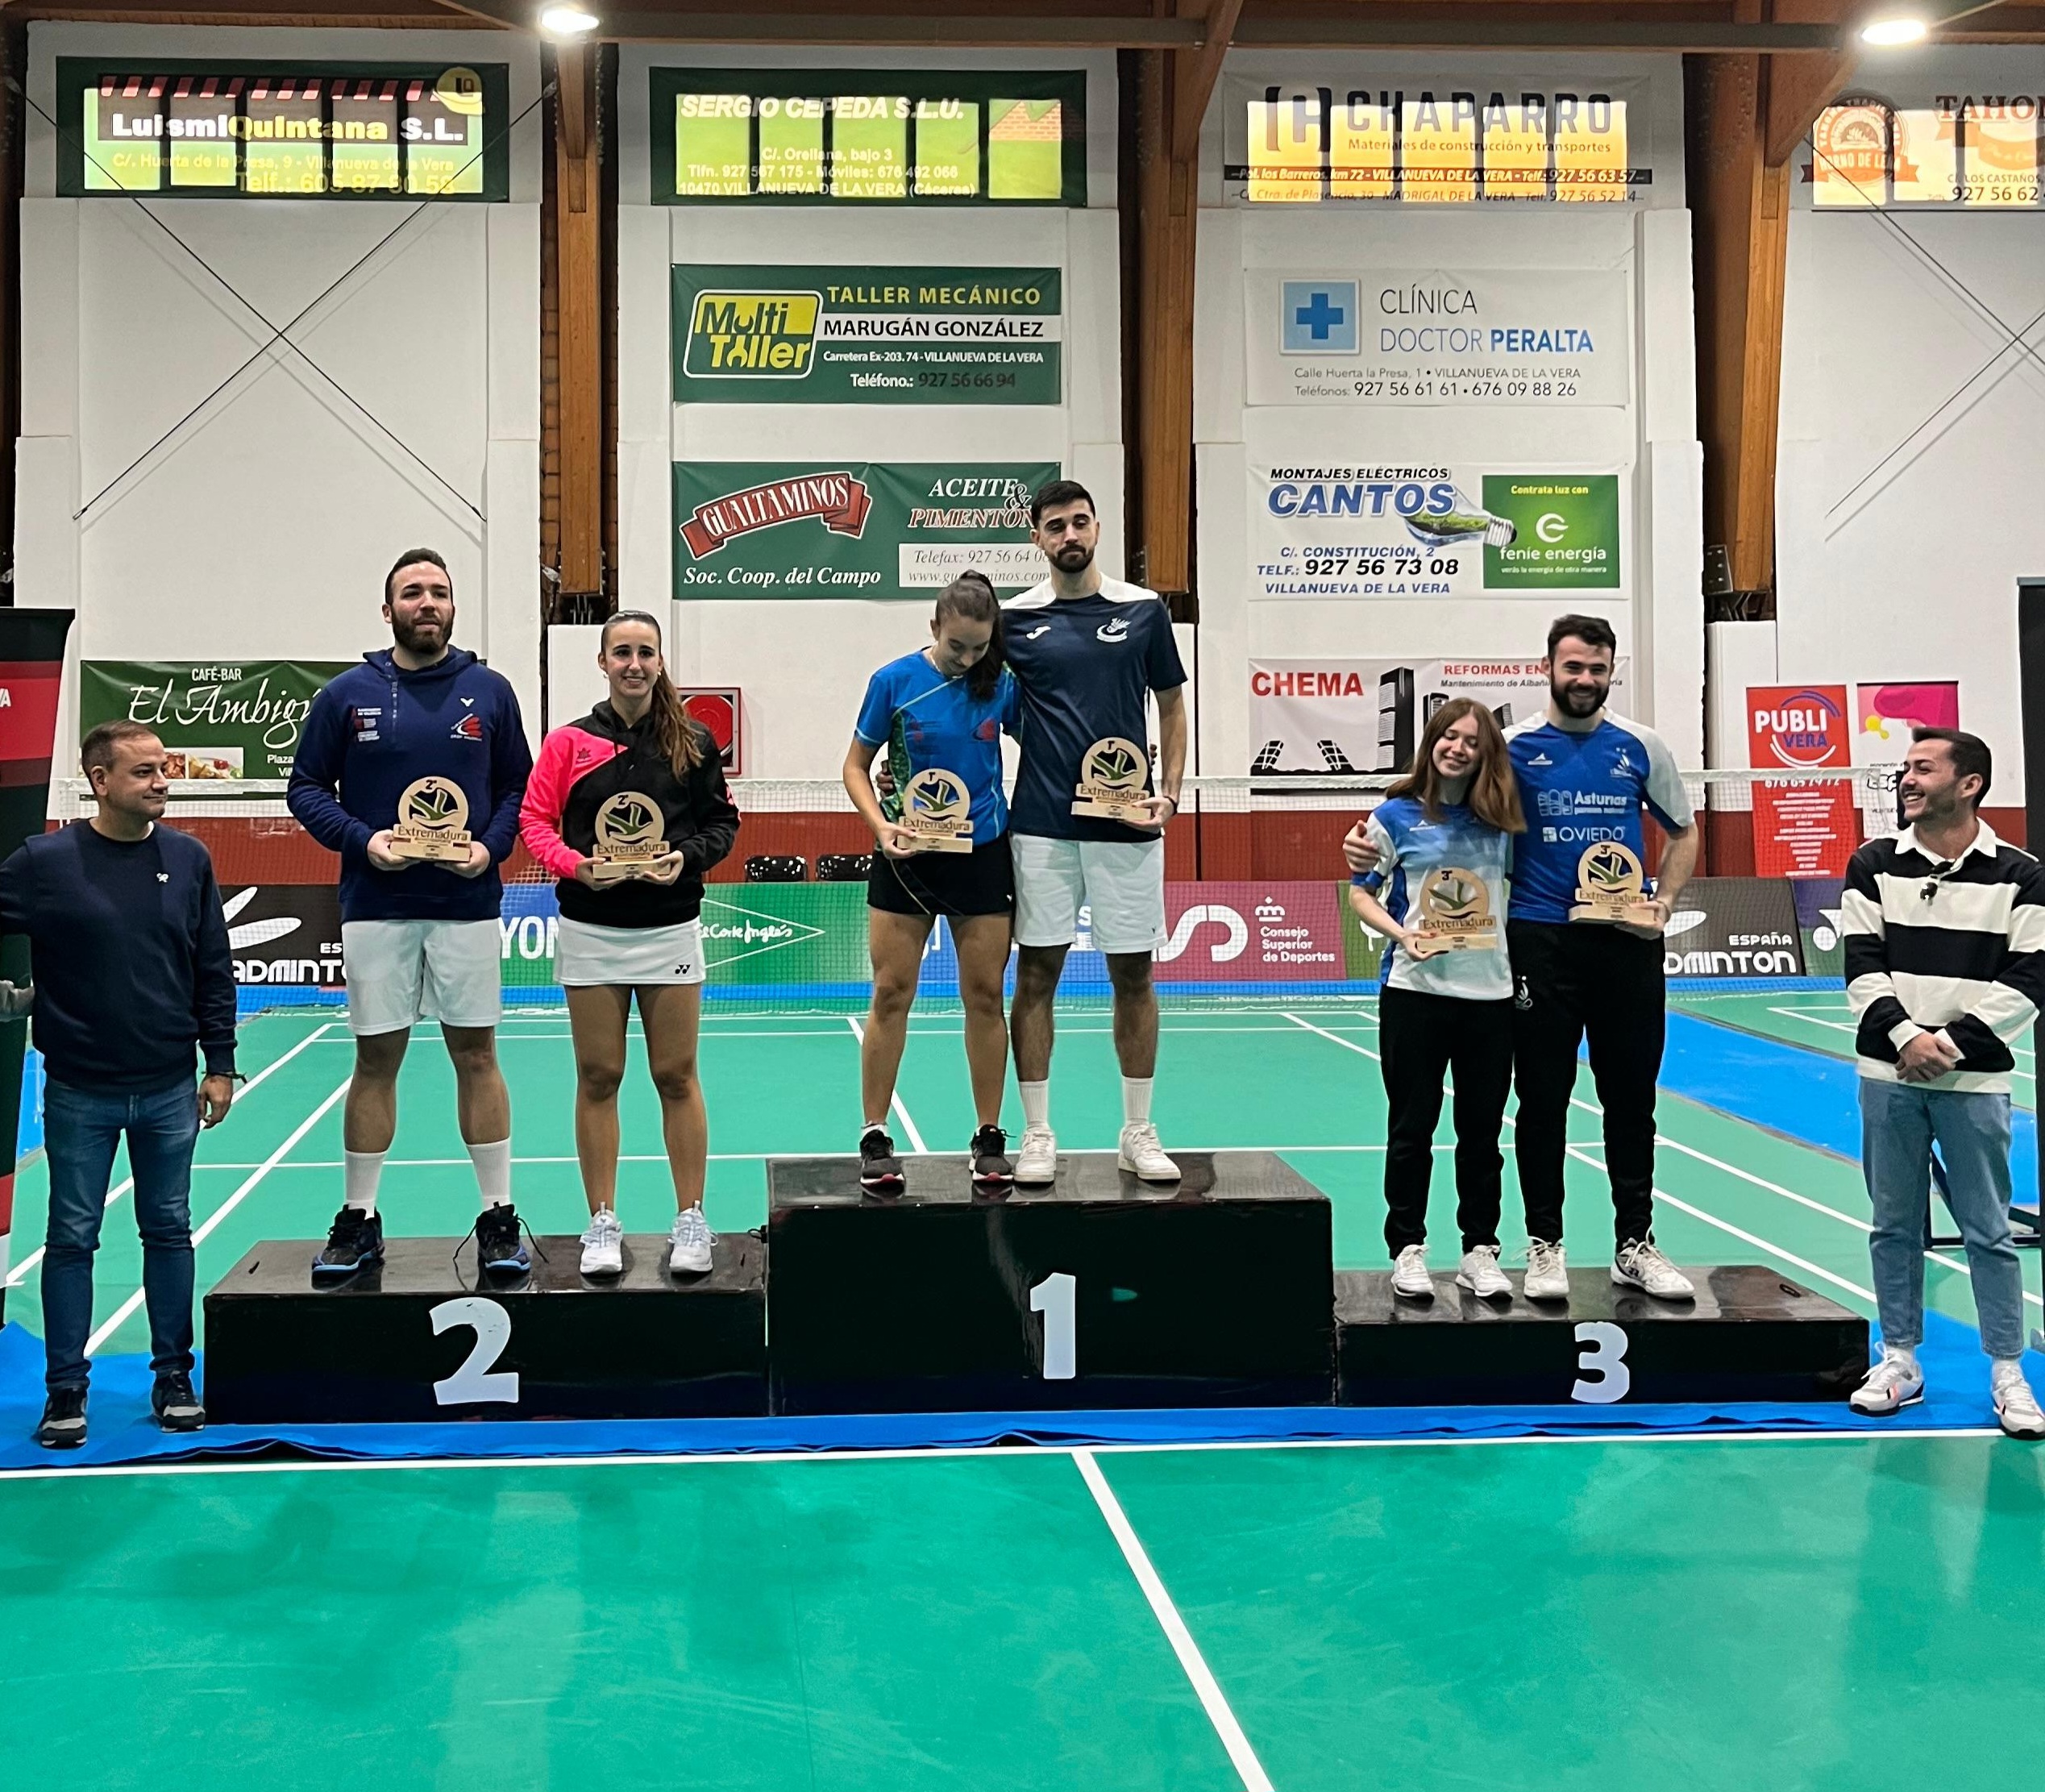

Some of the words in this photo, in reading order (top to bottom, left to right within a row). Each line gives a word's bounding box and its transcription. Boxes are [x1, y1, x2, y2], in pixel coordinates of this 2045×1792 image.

[680, 94, 779, 118] SERGIO
[785, 96, 888, 118] CEPEDA
[893, 96, 964, 119] S.L.U.
[1346, 89, 1611, 135] CHAPARRO
[400, 117, 463, 141] S.L.
[1348, 139, 1416, 151] Materiales
[1420, 139, 1436, 151] de
[1439, 140, 1521, 152] construcción
[1526, 143, 1532, 154] y
[1537, 143, 1611, 154] transportes
[140, 153, 189, 168] Huerta
[193, 154, 211, 168] de
[216, 154, 229, 168] la
[421, 156, 454, 171] Vera
[850, 148, 880, 163] bajo
[883, 148, 892, 160] 3
[721, 164, 746, 177] 927
[779, 164, 804, 177] 175
[1261, 168, 1278, 179] los
[1331, 168, 1349, 180] km
[1349, 169, 1365, 180] 72
[1372, 169, 1445, 181] VILLANUEVA
[1446, 169, 1464, 181] DE
[1464, 170, 1480, 181] LA
[1483, 170, 1513, 181] VERA
[1548, 169, 1576, 182] 927
[1577, 169, 1596, 181] 56
[1598, 169, 1615, 181] 63
[1618, 169, 1636, 182] 57
[723, 182, 815, 195] VILLANUEVA
[819, 182, 839, 195] DE
[842, 183, 865, 195] LA
[865, 183, 906, 195] VERA
[1549, 190, 1576, 202] 927
[1952, 186, 1985, 202] 927
[1991, 186, 2012, 202] 56
[2018, 186, 2039, 202] 62
[827, 286, 910, 304] TALLER
[919, 285, 1041, 305] MECÁNICO
[1380, 284, 1478, 314] CLÍNICA
[824, 317, 930, 336] MARUGÁN
[934, 318, 1044, 337] GONZÁLEZ
[1381, 328, 1483, 352] DOCTOR
[1490, 329, 1594, 352] PERALTA
[823, 351, 868, 362] Carretera
[924, 351, 987, 363] VILLANUEVA
[987, 352, 1002, 363] DE
[1003, 352, 1018, 363] LA
[1017, 352, 1044, 363] VERA
[850, 372, 914, 388] Teléfono.:
[918, 372, 948, 388] 927
[950, 372, 971, 388] 56
[1294, 368, 1323, 378] Calle
[1326, 368, 1363, 378] Huerta
[1366, 368, 1376, 378] la
[1379, 368, 1411, 380] Presa,
[1416, 368, 1421, 378] 1
[1435, 368, 1509, 378] VILLANUEVA
[1512, 368, 1528, 378] DE
[1532, 368, 1547, 378] LA
[1550, 368, 1582, 378] VERA
[1294, 385, 1351, 397] Teléfonos:
[1354, 381, 1383, 397] 927
[1389, 381, 1409, 397] 56
[1415, 381, 1432, 397] 61
[1440, 381, 1457, 397] 61
[1472, 381, 1503, 397] 676
[1507, 381, 1528, 397] 09
[1532, 381, 1552, 397] 88
[1557, 381, 1577, 397] 26
[1270, 468, 1352, 480] MONTAJES
[1356, 466, 1449, 480] ELÉCTRICOS
[928, 478, 1019, 497] ACEITE
[1511, 484, 1553, 495] Contrata
[1554, 484, 1570, 494] luz
[1571, 486, 1589, 494] con
[1004, 483, 1033, 512] &
[1267, 483, 1455, 515] CANTOS
[701, 476, 850, 538] GUALTAMINOS
[914, 550, 964, 567] Telefax:
[968, 550, 992, 563] 927
[994, 550, 1011, 563] 56
[1014, 550, 1029, 563] 64
[1280, 547, 1298, 558] C/.
[1303, 544, 1421, 559] CONSTITUCIÓN,
[1426, 547, 1435, 558] 2
[1544, 546, 1606, 563] energía
[1257, 565, 1299, 576] TELF.:
[1304, 559, 1349, 576] 927
[1356, 559, 1386, 576] 56
[1394, 559, 1422, 576] 73
[1430, 559, 1459, 576] 08
[684, 567, 723, 584] Soc.
[727, 567, 780, 588] Coop.
[784, 567, 813, 584] del
[817, 567, 882, 588] Campo
[1265, 583, 1358, 594] VILLANUEVA
[1364, 583, 1382, 594] DE
[1387, 583, 1406, 594] LA
[1411, 583, 1450, 594] VERA
[191, 666, 242, 681] CAFÉ-BAR
[1444, 664, 1521, 676] REFORMAS
[1250, 671, 1365, 697] CHEMA
[1440, 680, 1505, 688] Mantenimiento
[127, 677, 174, 725] El
[1754, 708, 1828, 734] PUBLI
[1782, 734, 1828, 748] VERA
[267, 754, 294, 764] Plaza
[1080, 785, 1146, 800] Extremadura
[1574, 790, 1627, 806] Asturias
[903, 817, 970, 831] Extremadura
[397, 826, 468, 841] Extremadura
[1559, 825, 1625, 842] OVIEDO
[597, 842, 666, 854] Extremadura
[1579, 889, 1644, 903] Extremadura
[1423, 917, 1493, 930] Extremadura
[1260, 926, 1309, 942] Consejo
[1728, 931, 1793, 946] ESPAÑA
[1261, 939, 1313, 952] Superior
[1262, 952, 1278, 963] de
[1280, 952, 1336, 964] Deportes
[1029, 1272, 1076, 1379] 1
[428, 1296, 519, 1405] 2
[1570, 1320, 1630, 1403] 3
